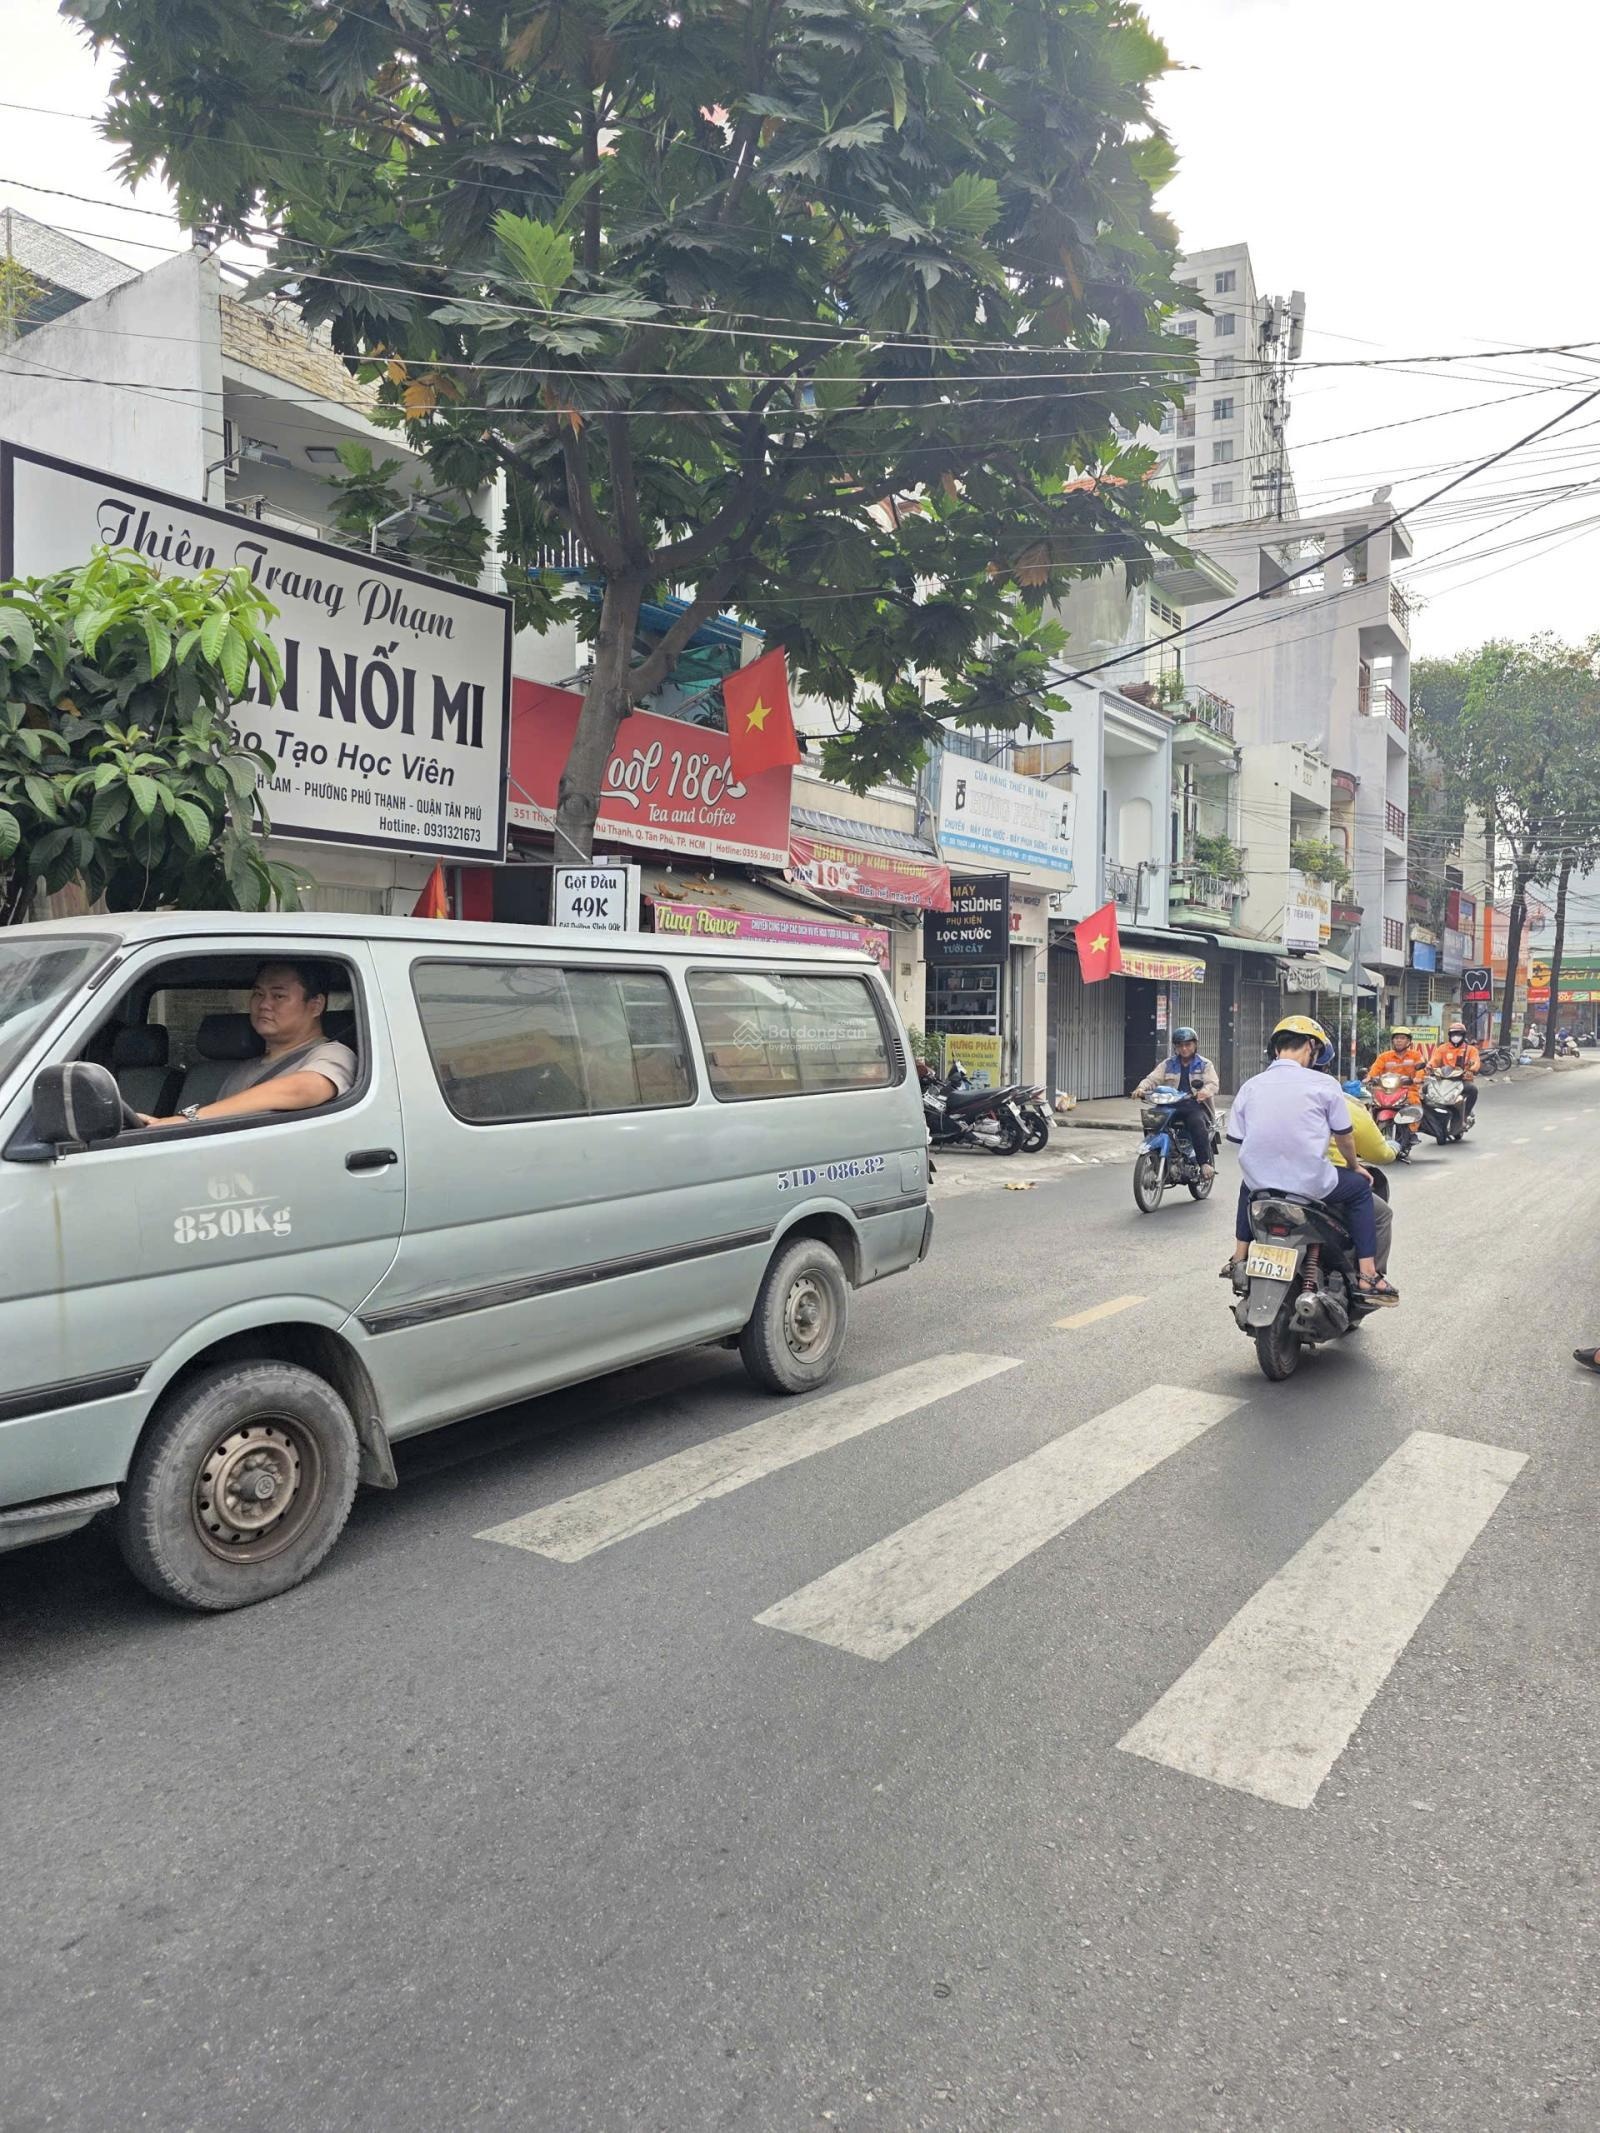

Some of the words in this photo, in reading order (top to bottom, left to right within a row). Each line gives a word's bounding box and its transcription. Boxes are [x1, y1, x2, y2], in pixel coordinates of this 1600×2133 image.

[97, 499, 215, 570] Thiên
[234, 541, 346, 617] Trang
[357, 579, 455, 639] Phạm
[318, 641, 416, 735] NỐI
[431, 674, 485, 748] MI
[275, 730, 328, 769] Tạo
[337, 742, 392, 779] Học
[402, 753, 455, 786] Viên
[304, 781, 347, 801] PHƯỜNG
[351, 788, 371, 805] PHÚ
[375, 792, 406, 811] THẠNH
[416, 798, 442, 817] QUẬN
[445, 801, 461, 819] TÂN
[464, 804, 482, 822] PHÚ
[513, 807, 531, 819] 351
[648, 802, 669, 823] Tea
[671, 807, 695, 824] and
[698, 806, 737, 828] Coffee
[379, 816, 421, 835] Hotline:
[424, 822, 482, 843] 0931321673
[689, 839, 706, 850] HCM
[716, 844, 742, 857] Hotline:
[564, 875, 587, 891] Gội
[591, 874, 617, 890] Đầu
[953, 883, 976, 897] MÁY
[571, 896, 608, 919] 49K
[946, 916, 962, 926] PHỤ
[963, 915, 983, 926] KIỆN
[696, 909, 741, 936] Flower
[936, 930, 959, 942] LỌC
[960, 928, 992, 941] NƯỚC
[976, 1040, 998, 1050] PHÁT
[777, 1156, 885, 1191] 51D-086.82
[173, 1206, 292, 1244] 850Kg
